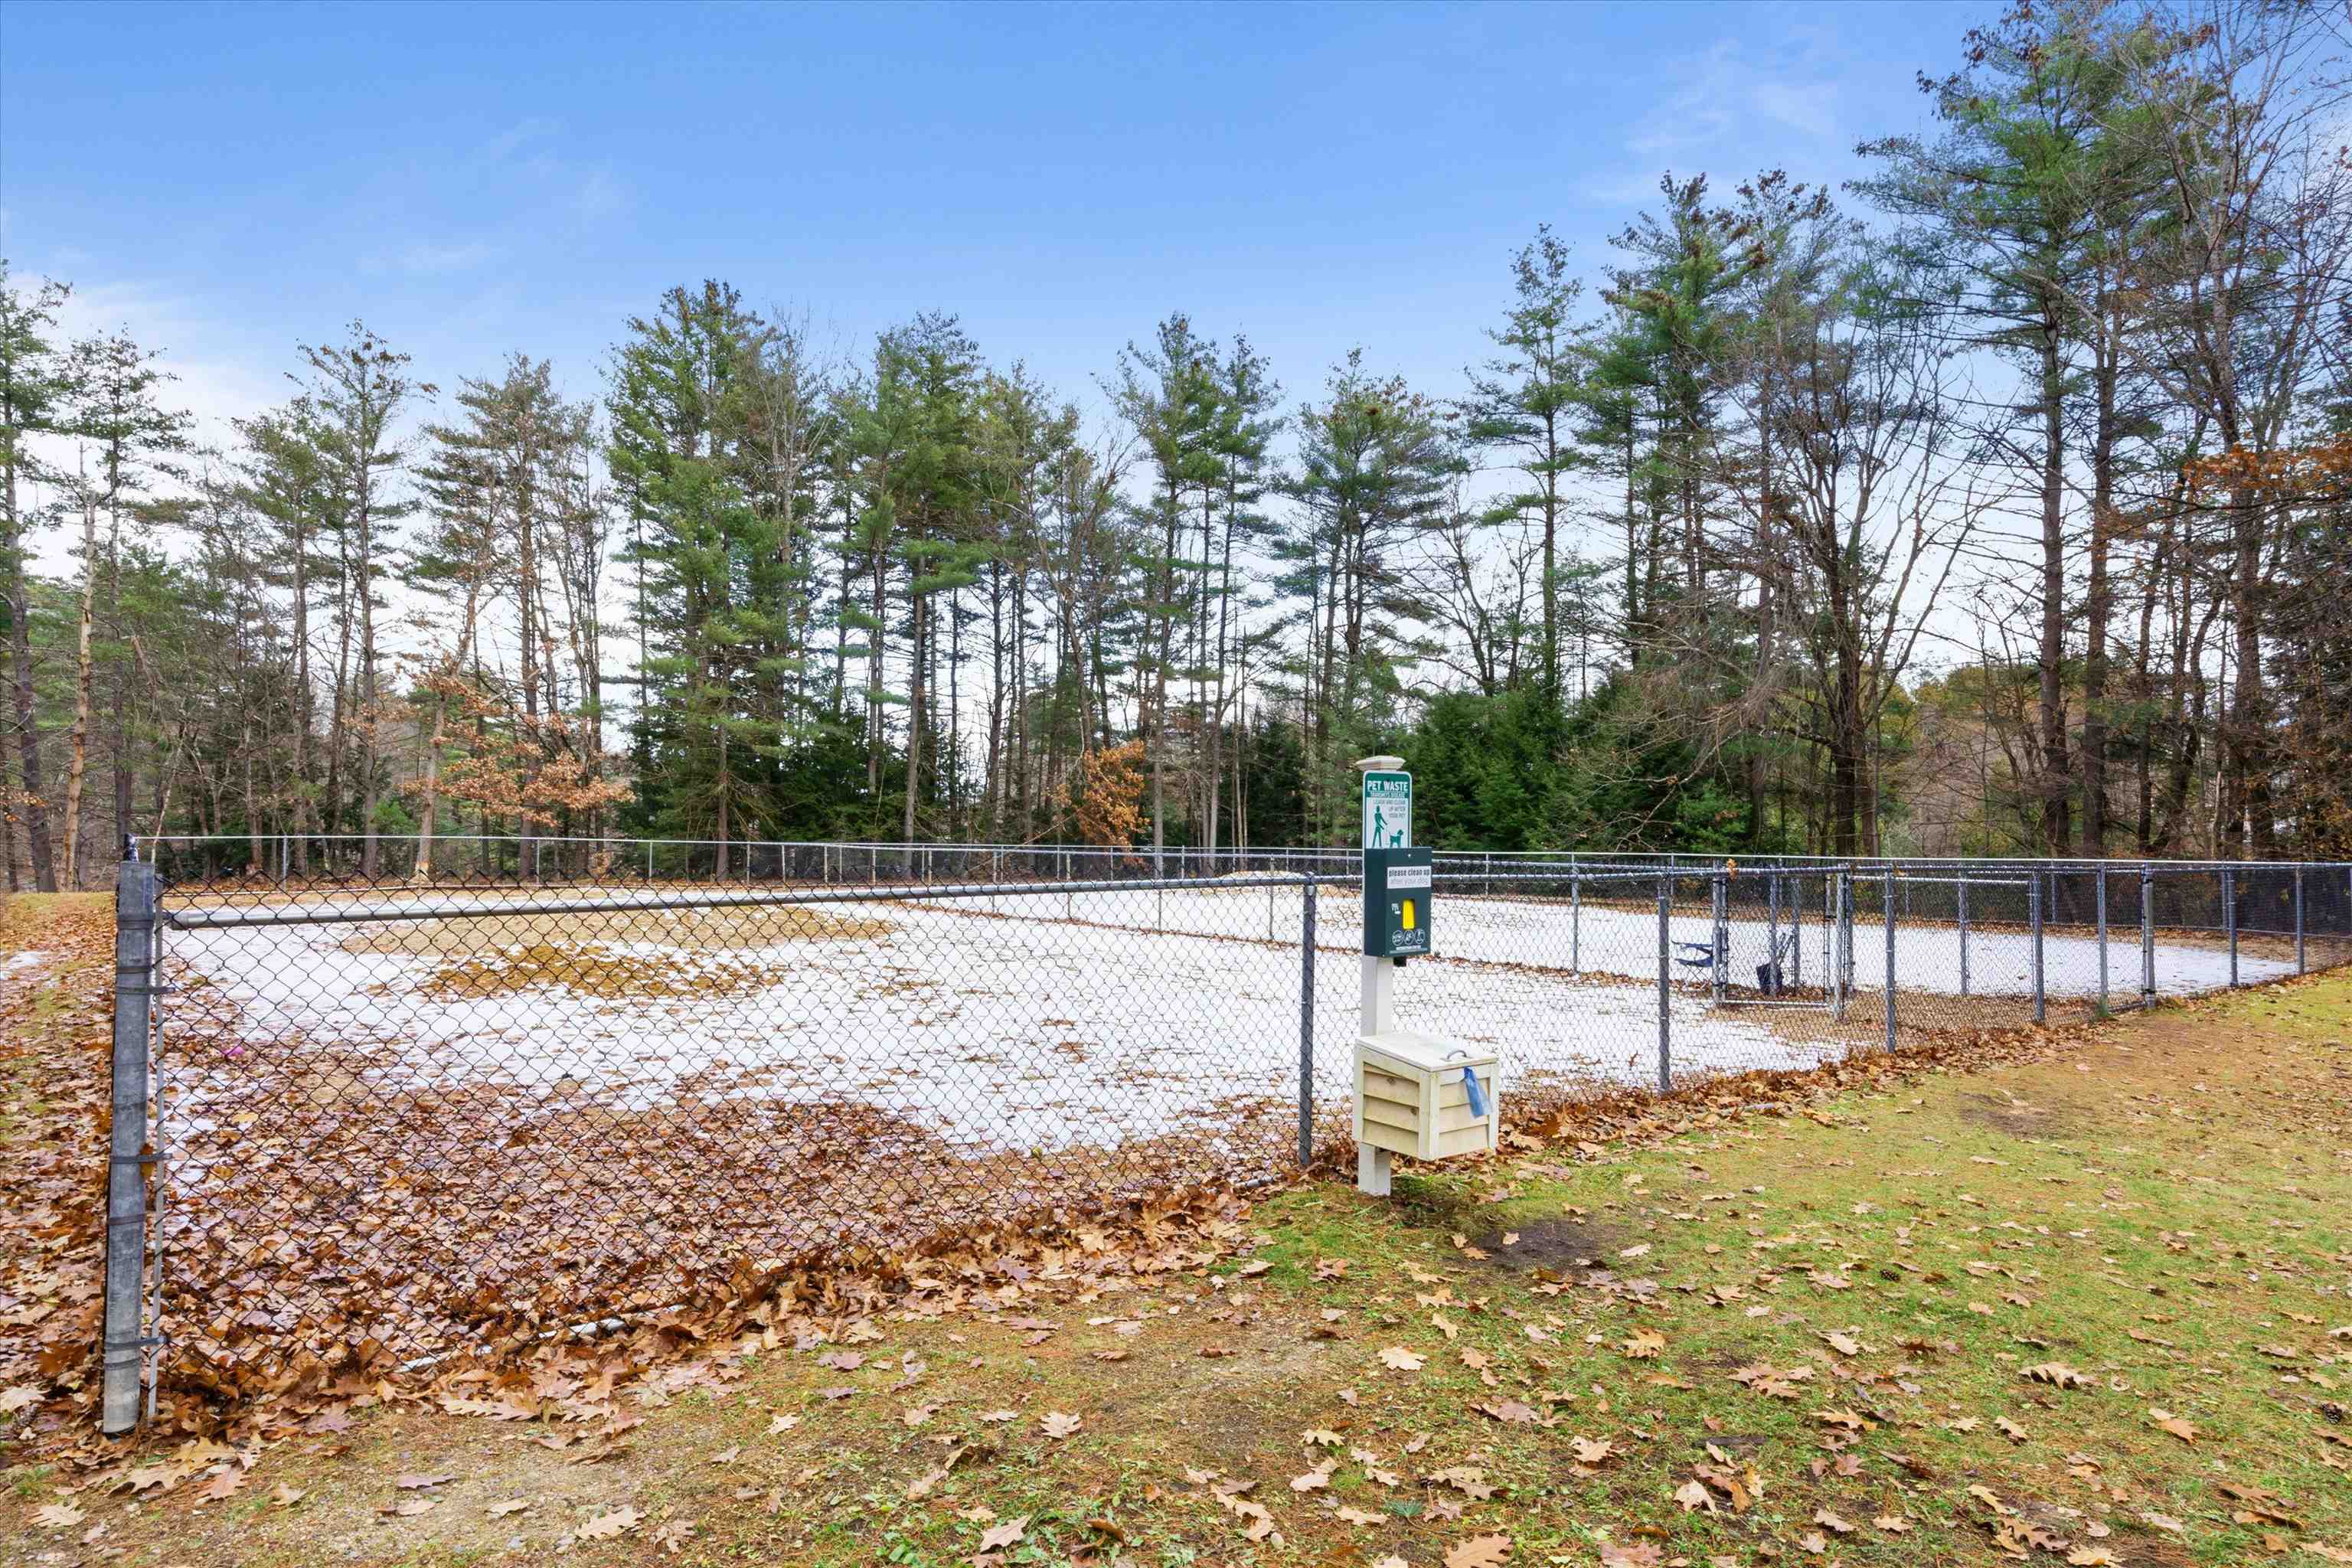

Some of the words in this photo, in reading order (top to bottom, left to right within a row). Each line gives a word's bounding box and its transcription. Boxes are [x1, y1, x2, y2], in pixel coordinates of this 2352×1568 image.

[1367, 780, 1381, 791] PET
[1384, 781, 1408, 791] WASTE
[1389, 869, 1406, 877] please
